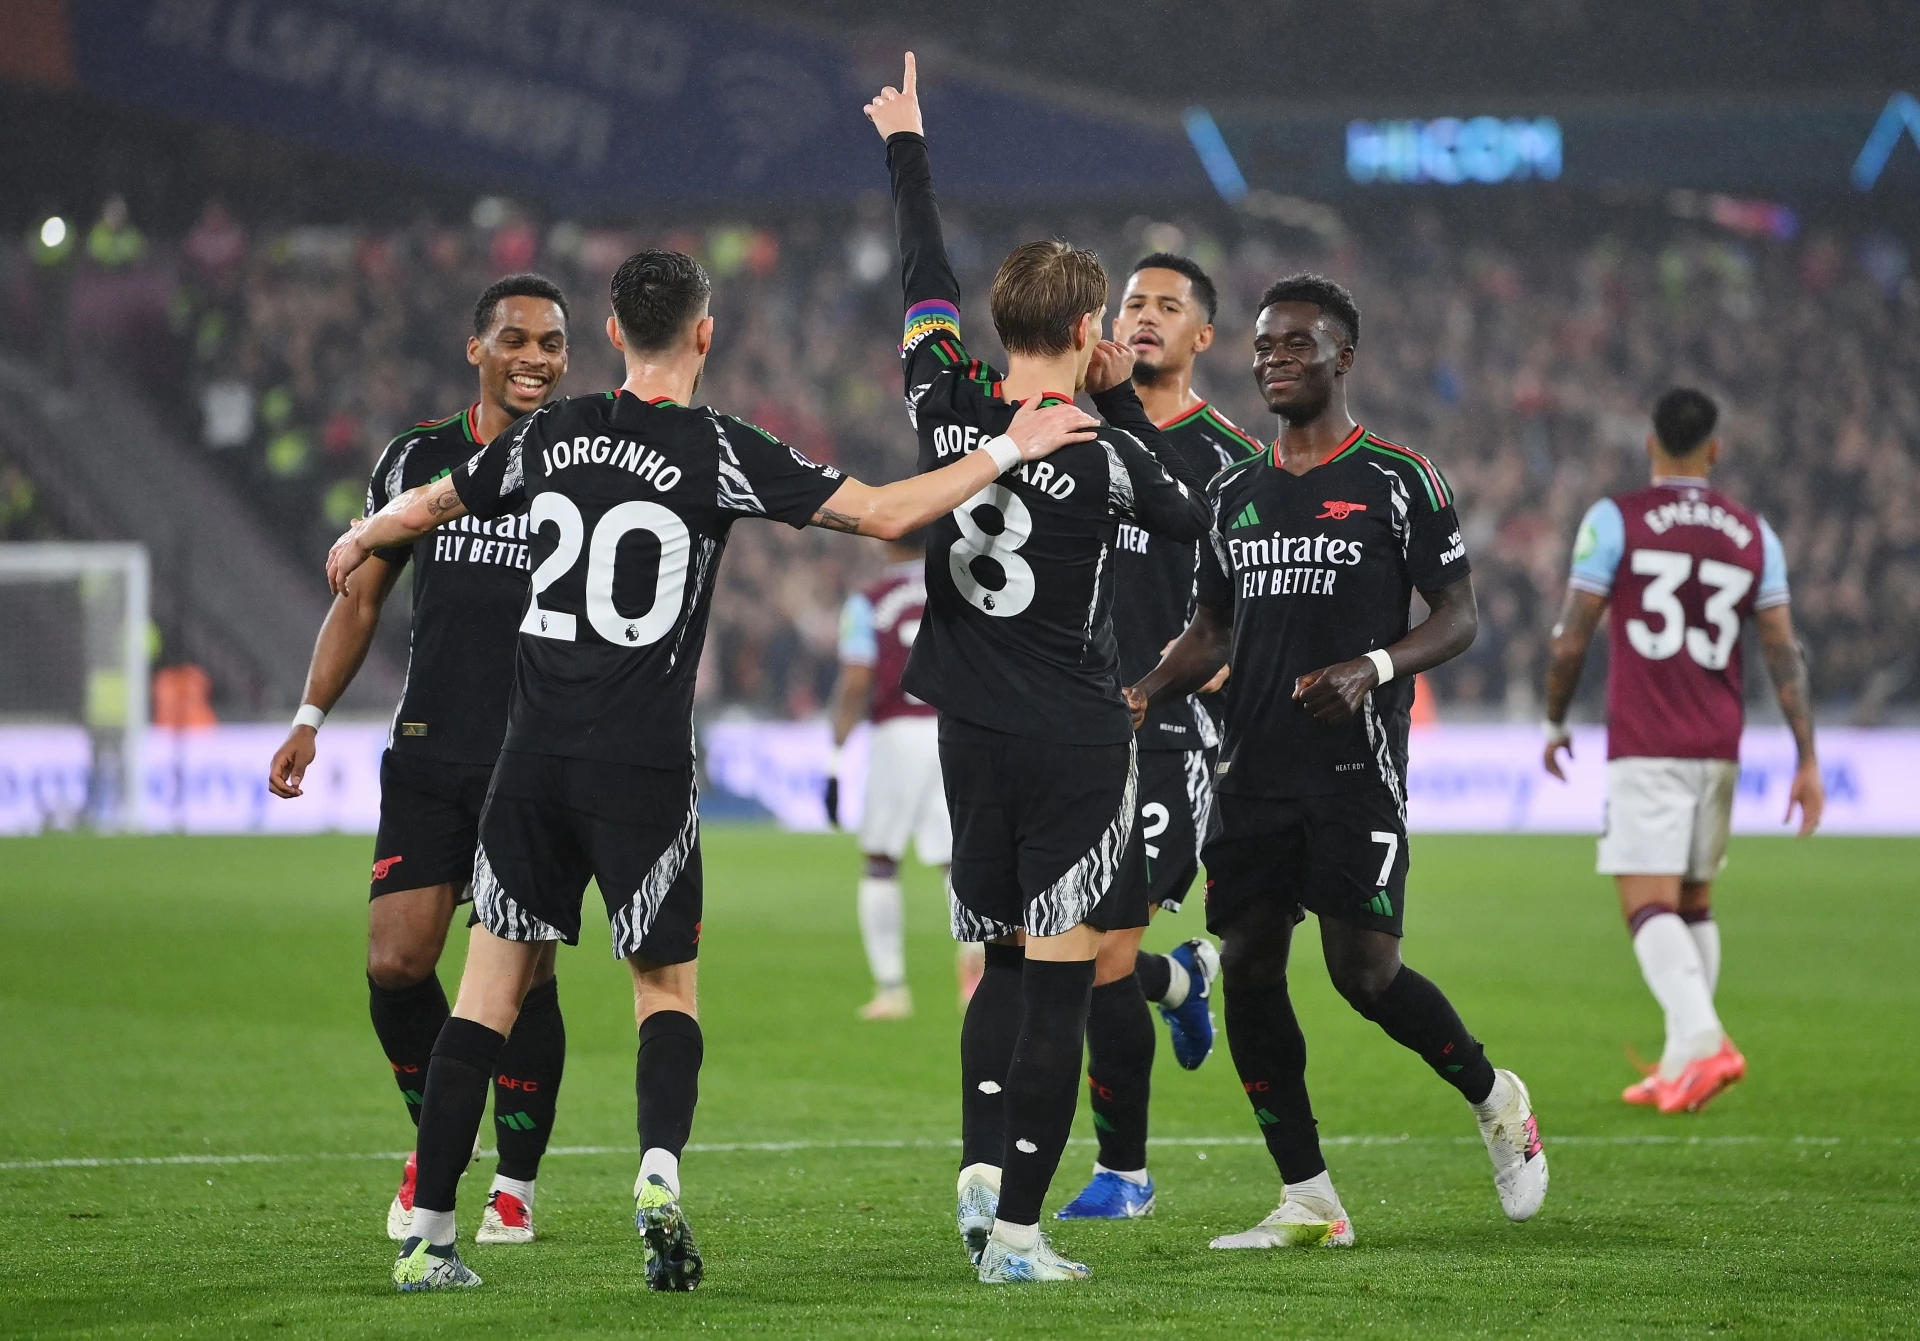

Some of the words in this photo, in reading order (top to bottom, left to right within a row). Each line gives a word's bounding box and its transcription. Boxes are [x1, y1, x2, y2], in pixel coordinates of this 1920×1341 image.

[543, 436, 682, 492] JORGINHO
[949, 483, 1036, 618] 8
[1115, 523, 1150, 554] TTER
[1643, 500, 1753, 549] EMERSON
[434, 535, 466, 562] FLY
[469, 538, 531, 571] BETTE
[520, 491, 691, 648] 20
[1228, 531, 1363, 571] Emirates
[1242, 570, 1268, 599] FLY
[1270, 568, 1337, 595] BETTER
[1625, 549, 1754, 672] 33
[1141, 802, 1170, 859] 2
[1371, 831, 1398, 887] 7
[497, 1074, 538, 1092] AFC
